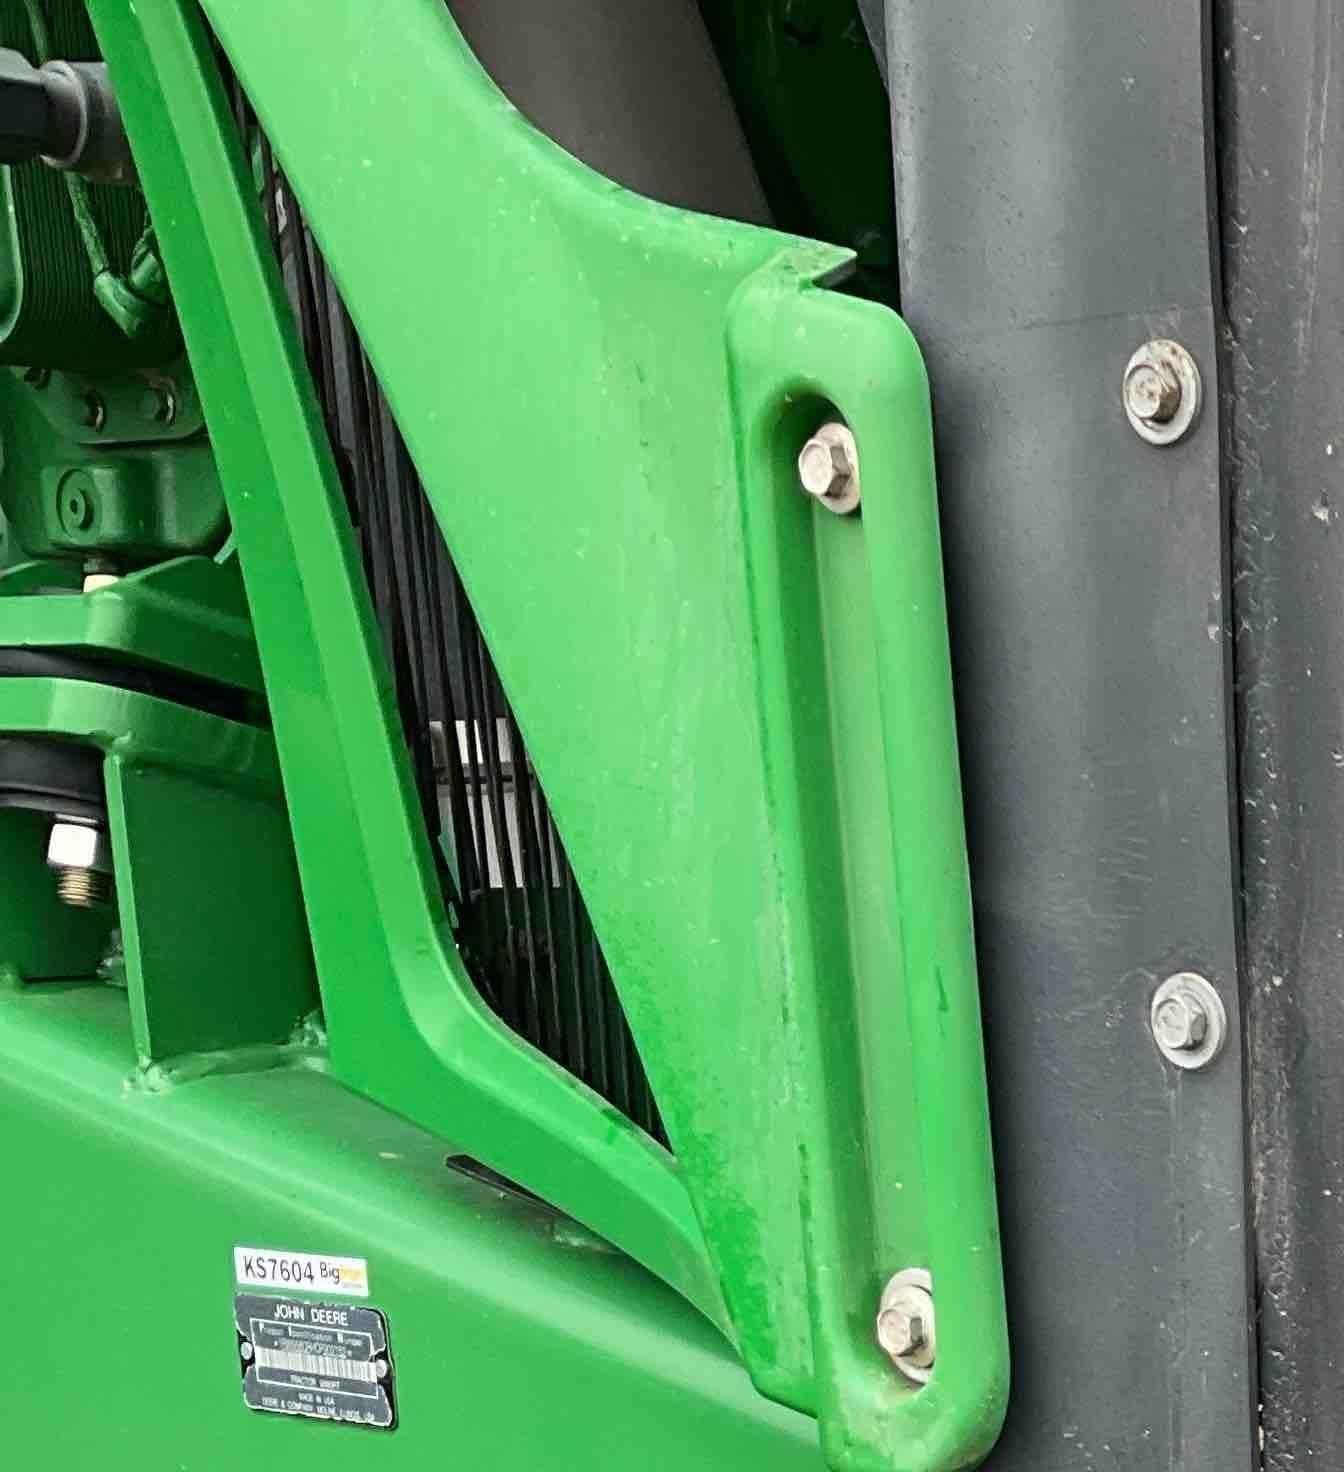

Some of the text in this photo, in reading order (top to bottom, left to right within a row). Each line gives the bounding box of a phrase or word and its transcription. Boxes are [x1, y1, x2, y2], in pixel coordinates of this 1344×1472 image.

[243, 1255, 315, 1286] KS7604
[274, 1303, 349, 1326] JOHN DEERE
